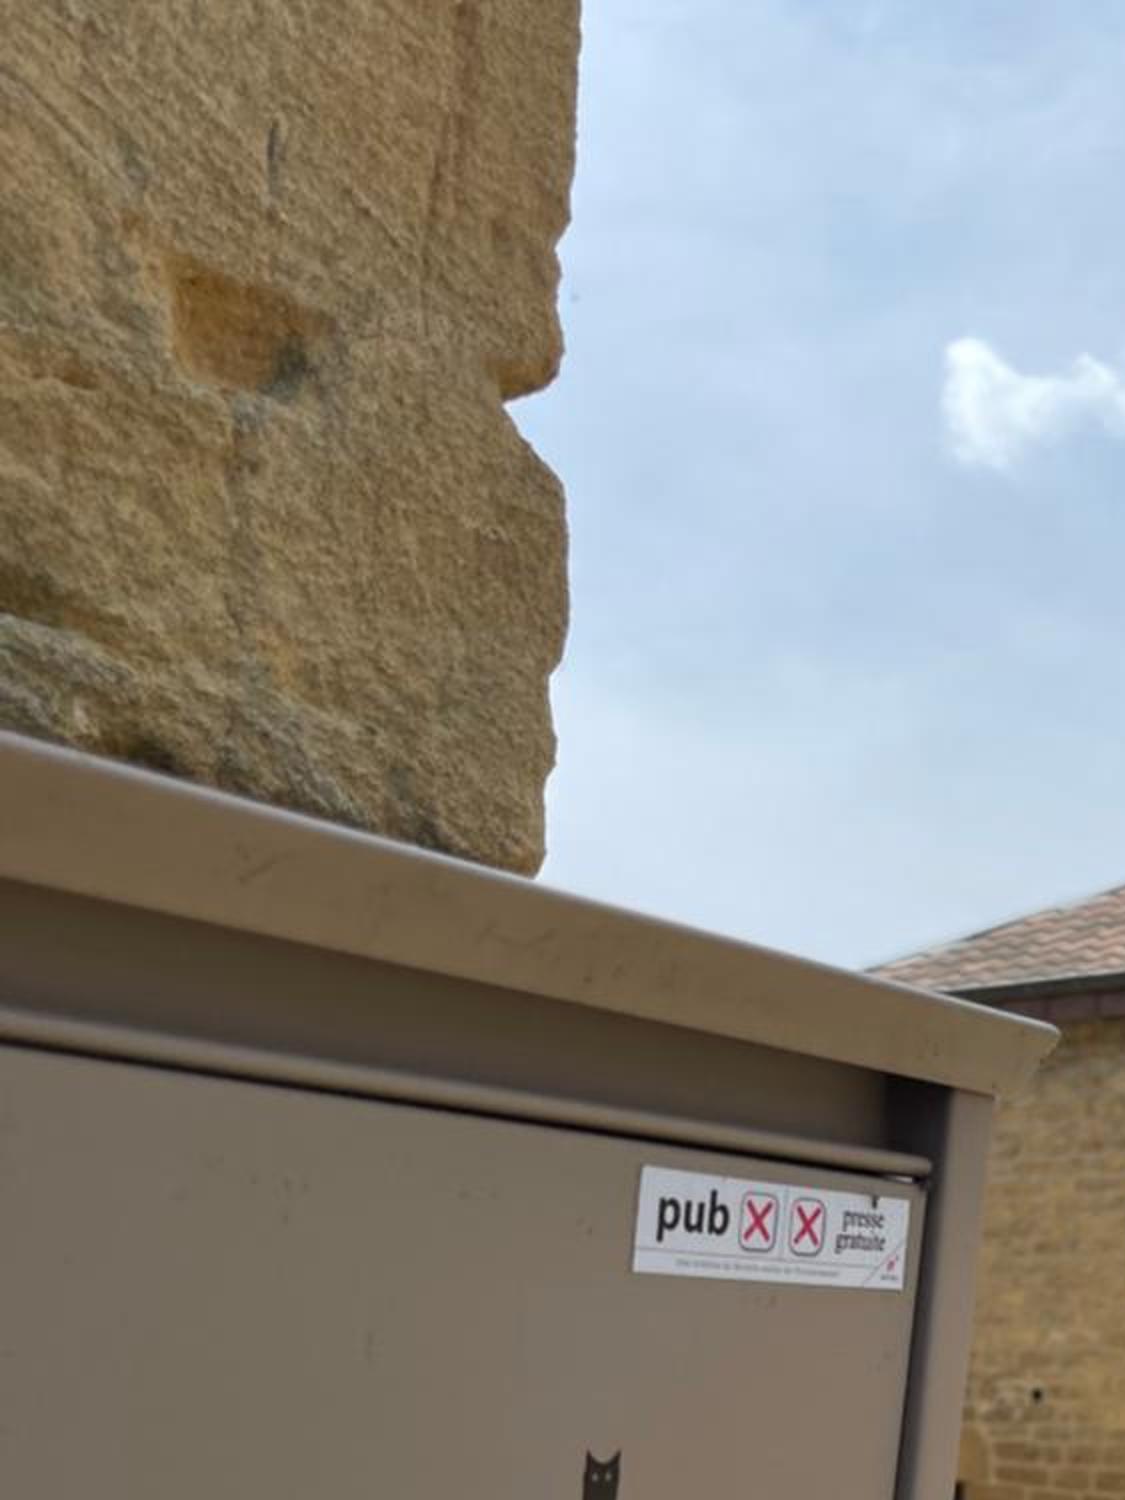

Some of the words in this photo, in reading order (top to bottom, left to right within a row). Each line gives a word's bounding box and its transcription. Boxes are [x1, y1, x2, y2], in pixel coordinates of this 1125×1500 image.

[656, 1189, 730, 1243] pub
[842, 1209, 885, 1231] presse
[834, 1230, 886, 1255] gratuite
